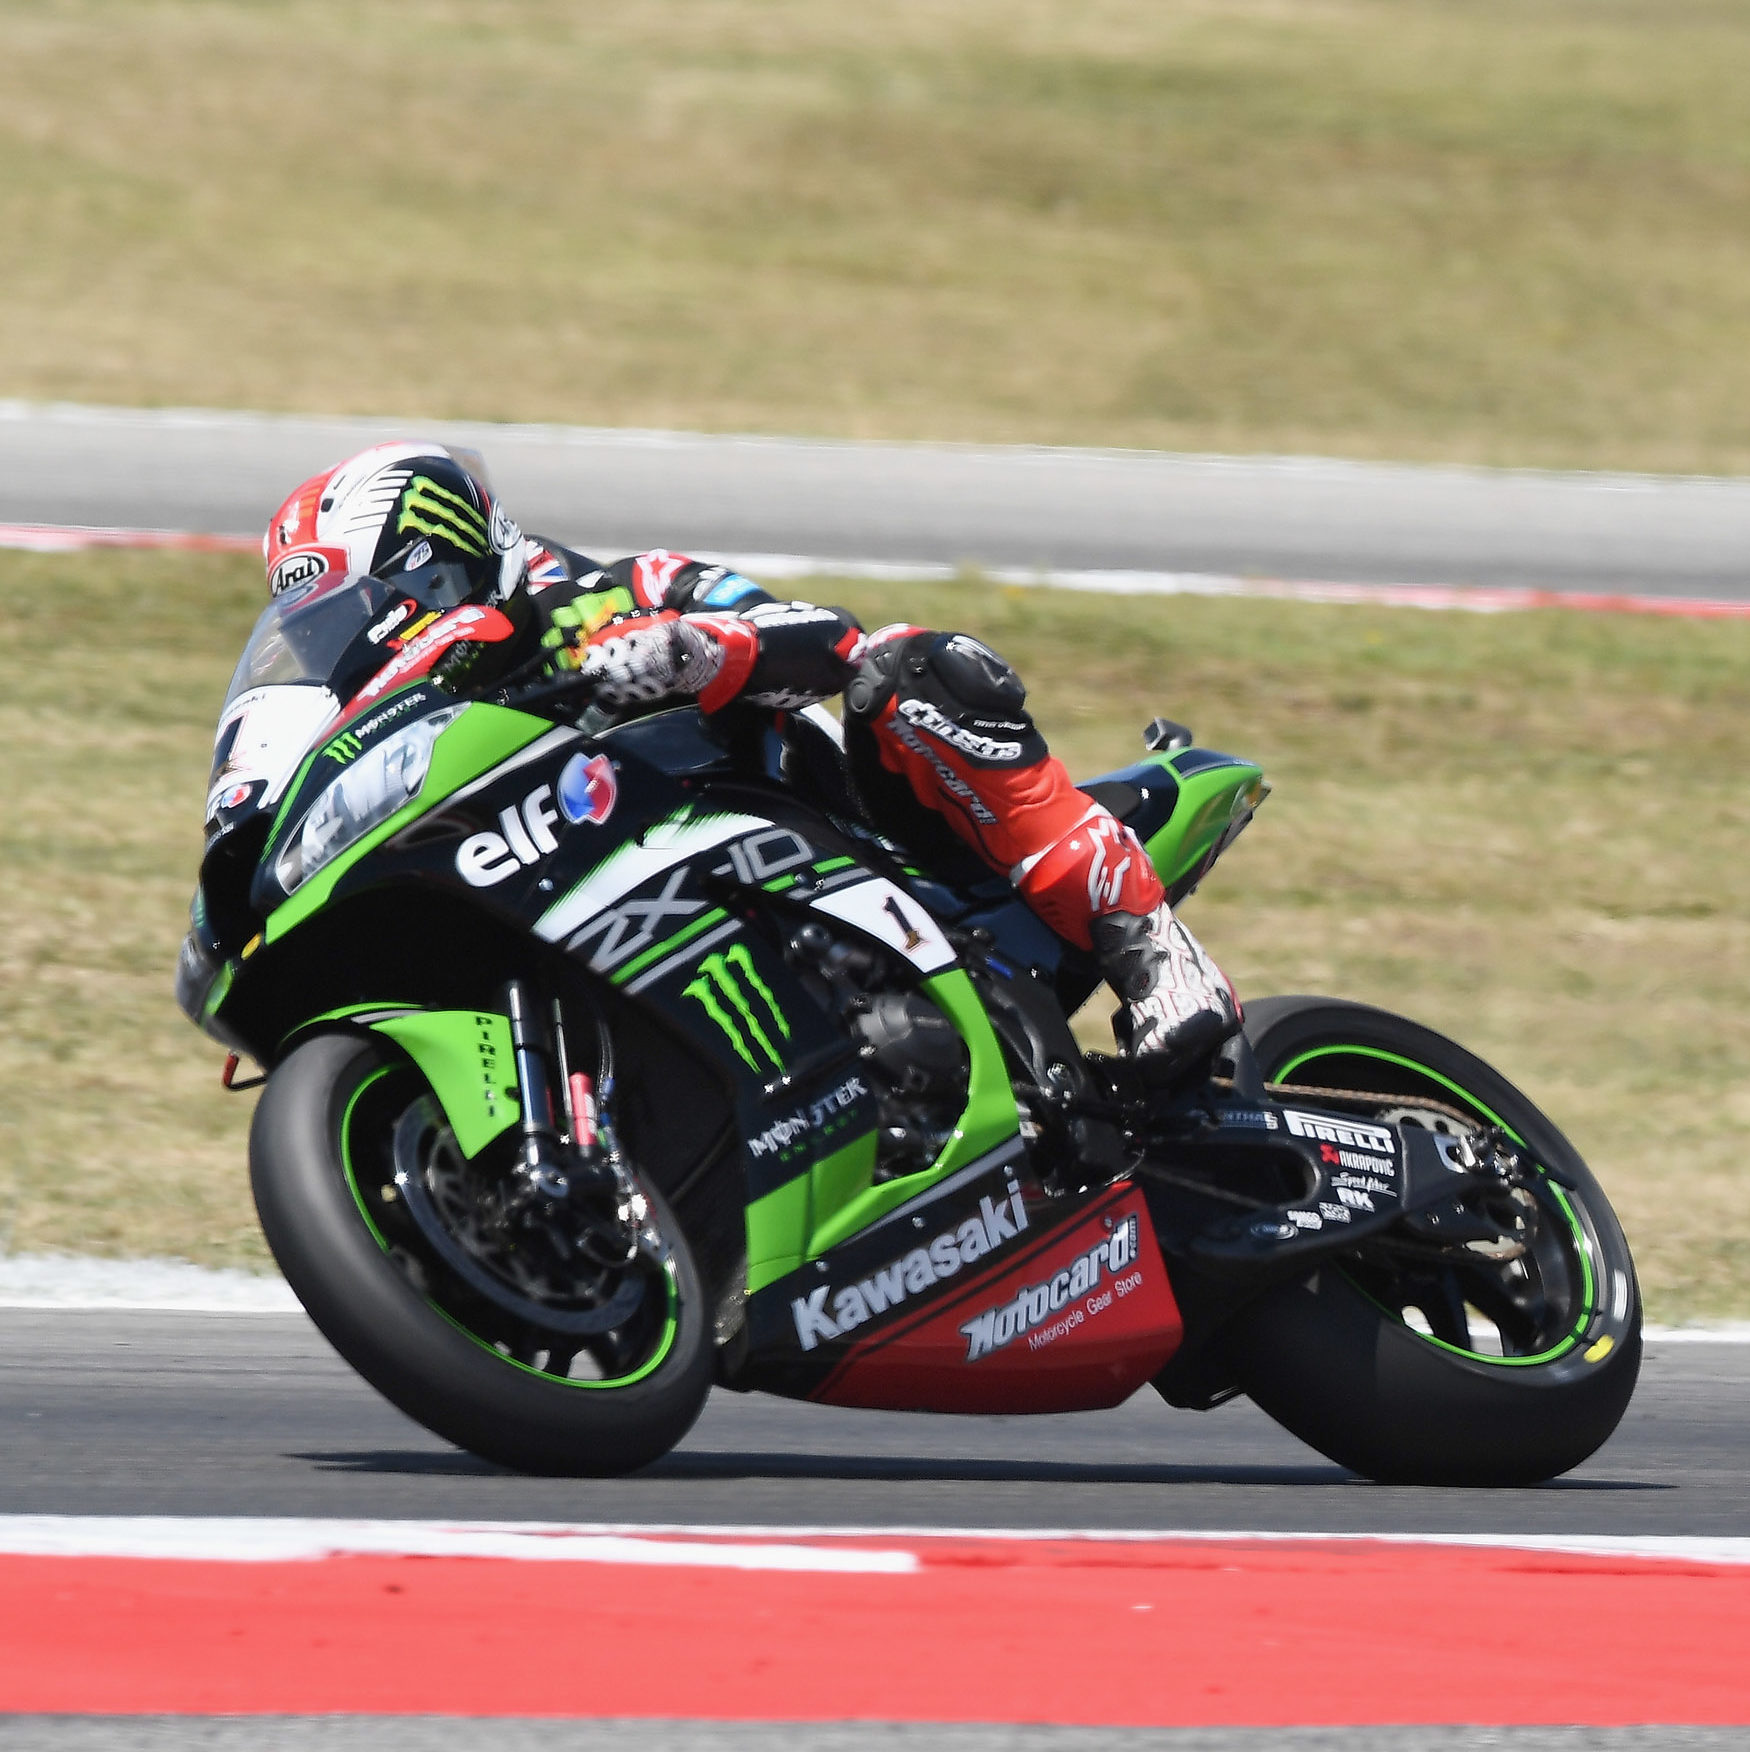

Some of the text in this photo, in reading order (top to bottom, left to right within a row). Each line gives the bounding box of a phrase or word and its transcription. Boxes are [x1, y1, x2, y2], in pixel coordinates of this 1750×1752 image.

[274, 555, 322, 592] Arai
[355, 692, 426, 739] MONSTER
[454, 785, 563, 889] elf
[882, 896, 929, 952] 1
[747, 1076, 868, 1158] MONSTER
[1283, 1110, 1396, 1154] PIRELLI
[791, 1179, 1028, 1352] Kawasaki
[1028, 1271, 1143, 1351] Motorcycle Gear Store
